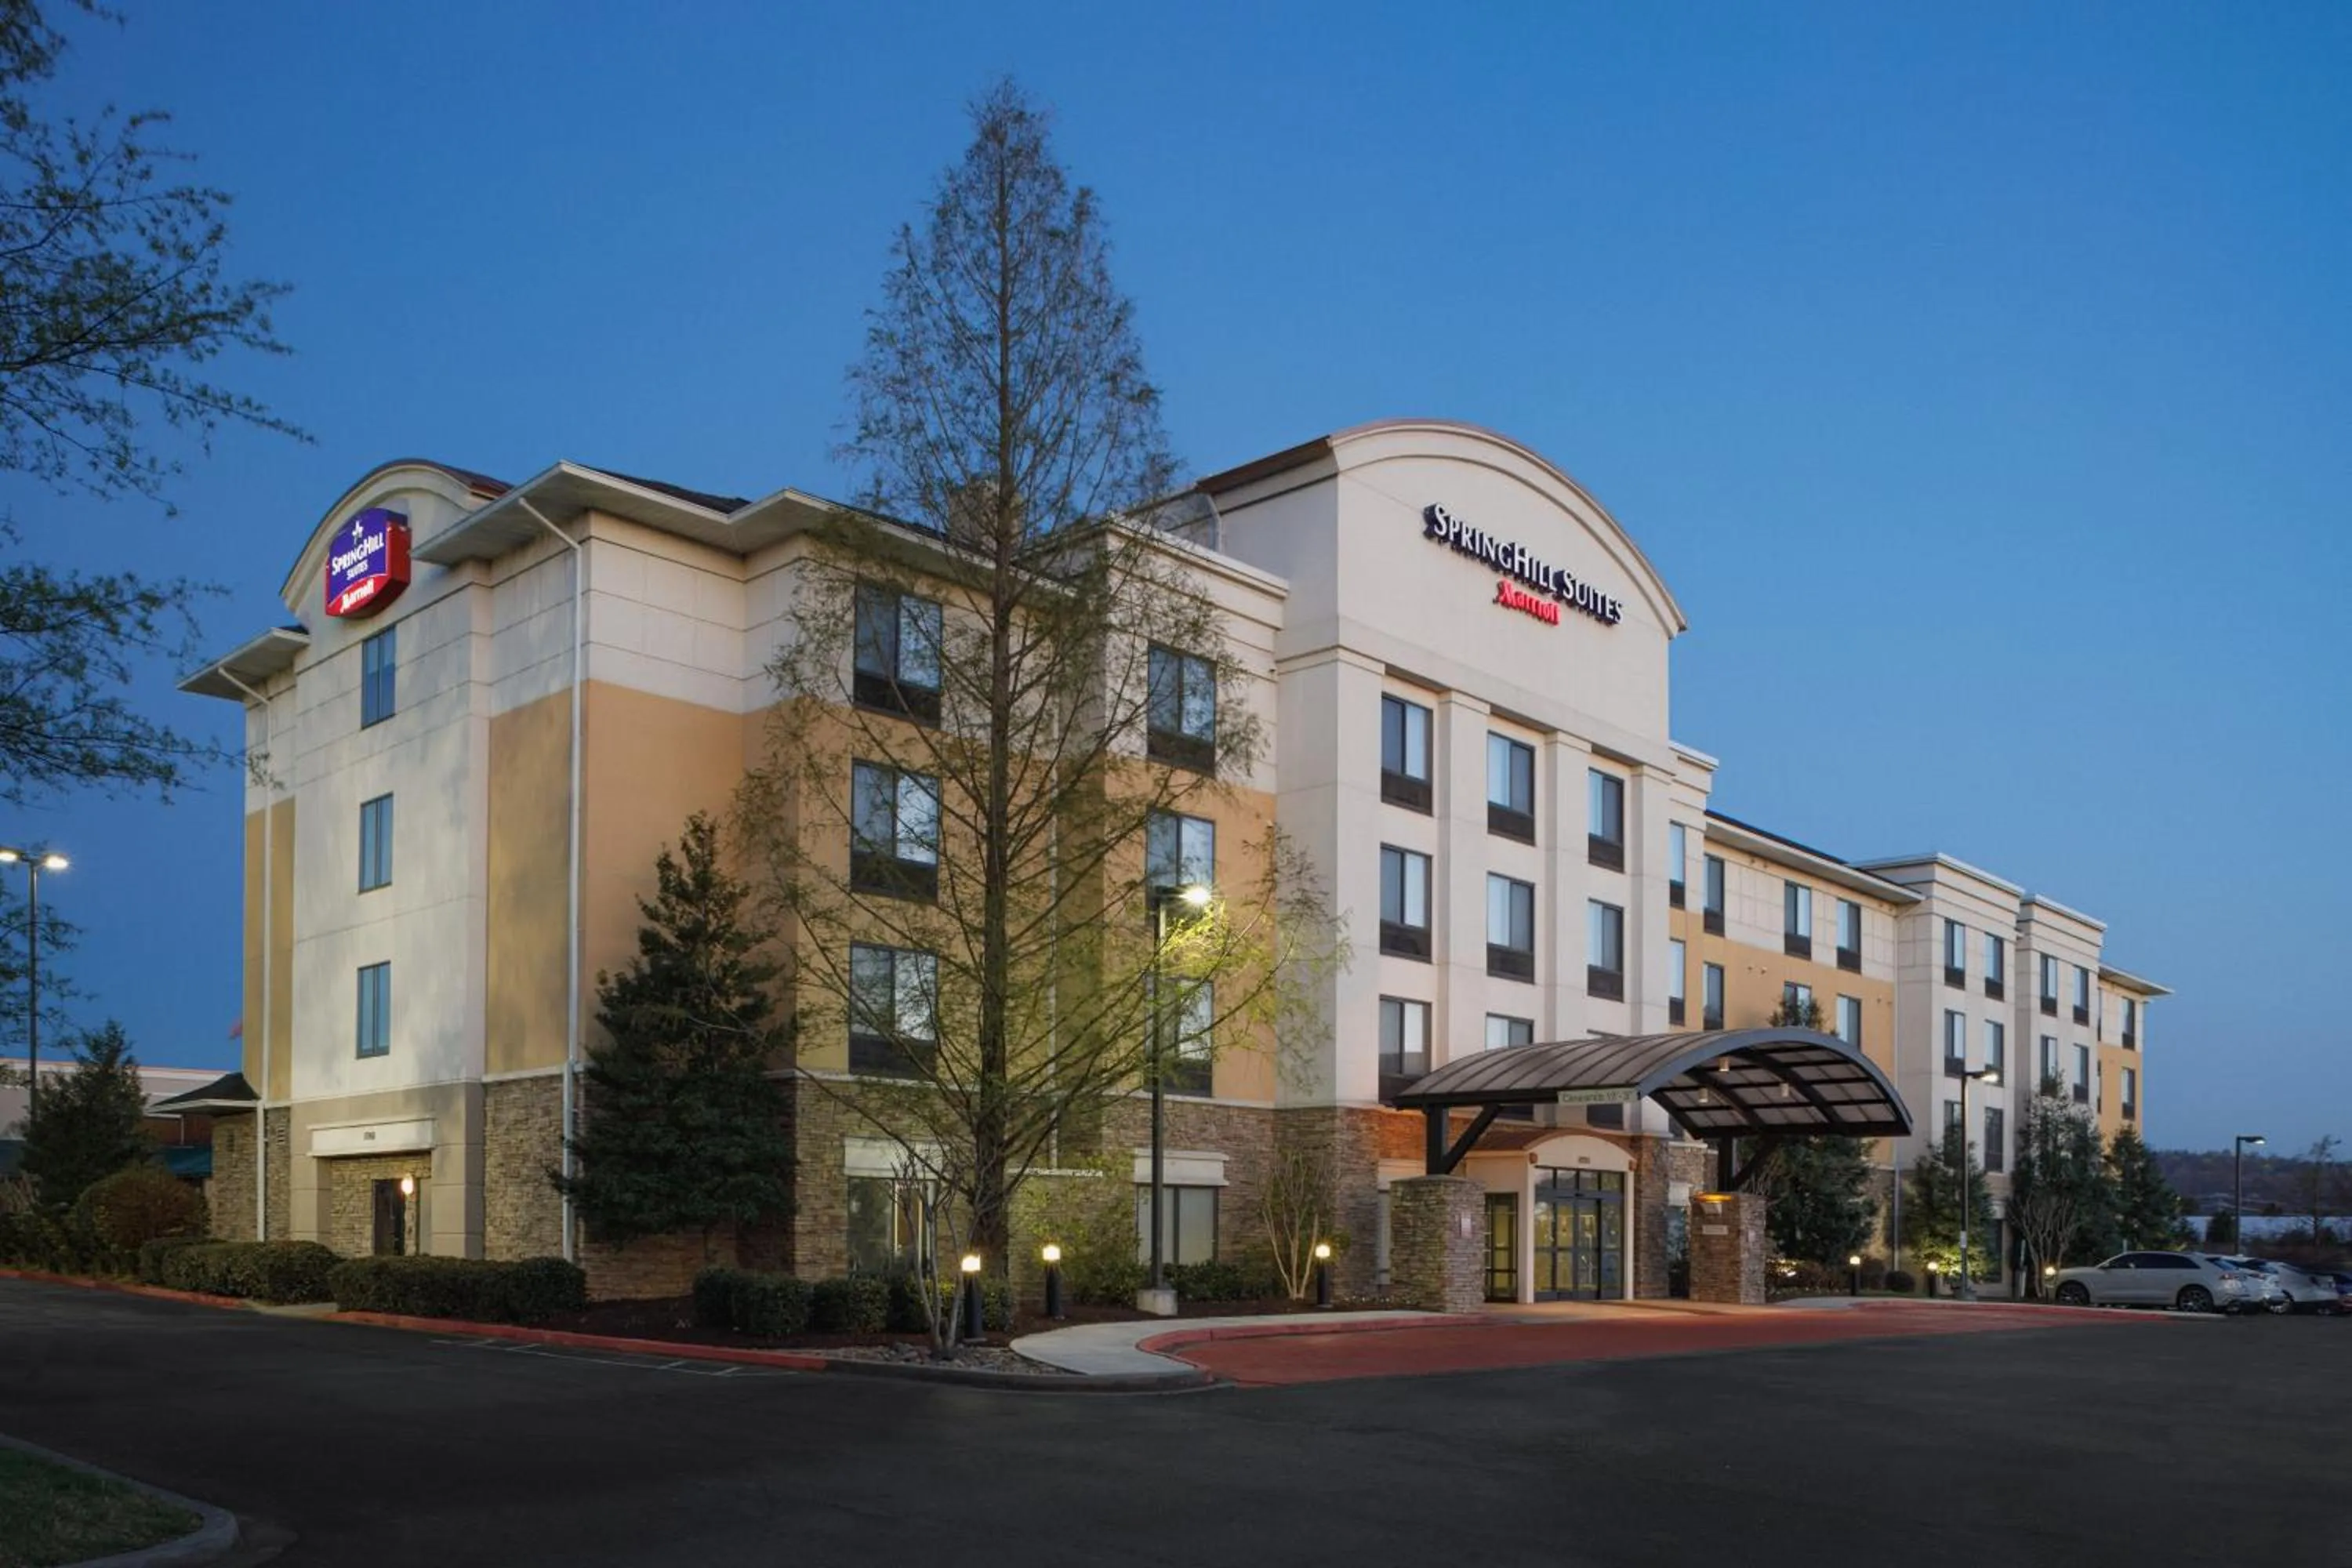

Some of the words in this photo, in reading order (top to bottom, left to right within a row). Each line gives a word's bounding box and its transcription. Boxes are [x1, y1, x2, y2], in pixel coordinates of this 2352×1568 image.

[332, 532, 384, 575] SPRINGHILL
[346, 559, 368, 581] SUITES
[1424, 503, 1557, 593] SPRINGHILL
[1562, 569, 1623, 624] SUITES
[339, 578, 374, 613] Marriott
[1494, 578, 1561, 626] Marriott
